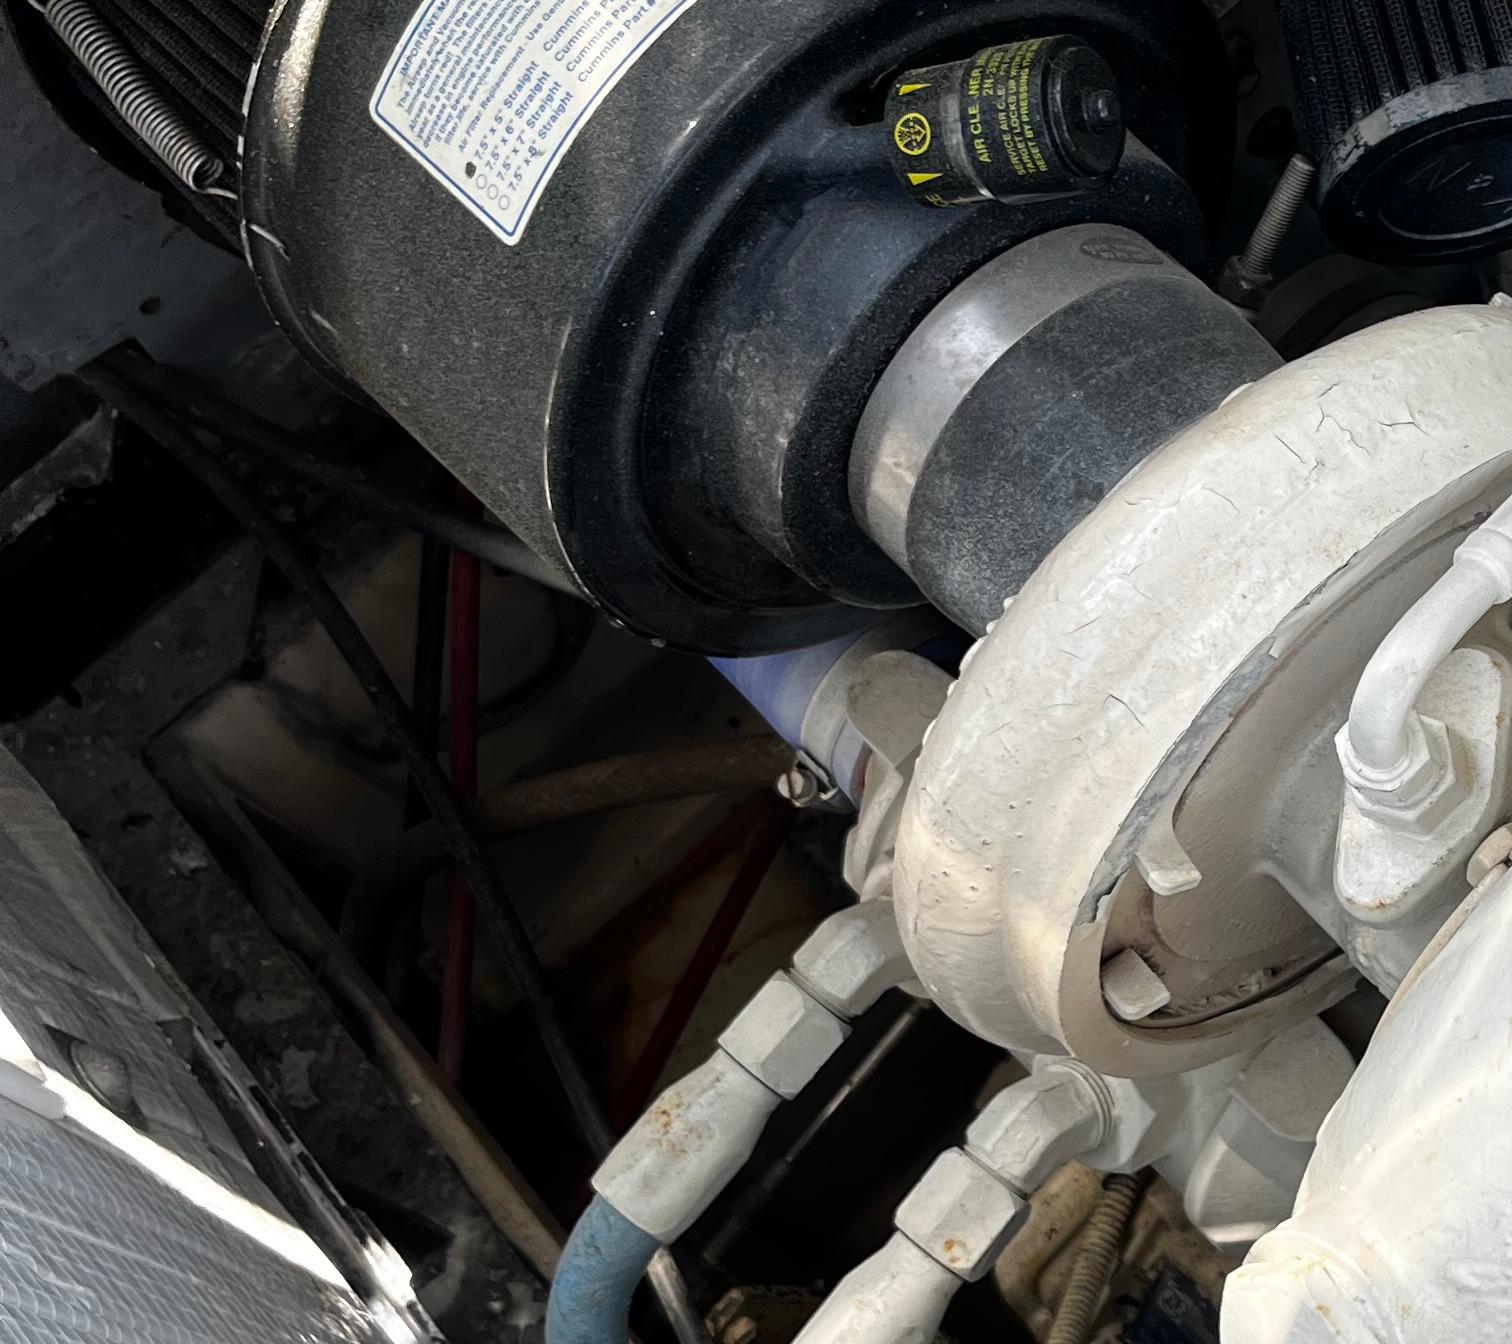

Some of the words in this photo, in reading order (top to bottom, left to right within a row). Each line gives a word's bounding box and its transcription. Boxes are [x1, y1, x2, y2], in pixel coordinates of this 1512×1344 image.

[398, 10, 440, 77] IMPORTANT
[422, 71, 441, 100] turns
[451, 27, 468, 49] The
[464, 0, 489, 30] filters
[453, 8, 469, 29] the
[396, 87, 410, 110] The
[423, 35, 439, 57] and
[416, 115, 430, 141] year
[437, 54, 464, 96] general
[422, 101, 447, 150] decrease
[449, 54, 475, 91] engine
[438, 109, 454, 136] they
[449, 69, 477, 112] become
[472, 23, 509, 71] saturated
[504, 2, 525, 25] with
[443, 119, 459, 146] filter
[465, 63, 492, 102] service
[487, 41, 507, 66] with
[457, 136, 468, 153] Air
[464, 108, 483, 137] Filter
[478, 45, 527, 111] Replacement
[524, 20, 545, 42] Use
[484, 143, 503, 172] 7.5"
[498, 134, 508, 146] x
[503, 117, 518, 136] 6"
[512, 68, 553, 121] Straight
[551, 7, 603, 63] Cummins
[495, 154, 514, 183] 7.5"
[510, 145, 520, 157] x
[515, 128, 530, 146] 7"
[524, 79, 564, 131] Straight
[563, 17, 616, 74] Cummins
[507, 164, 526, 193] 7.5"
[535, 89, 576, 141] Straight
[575, 28, 627, 84] Cummins
[621, 4, 649, 31] Part
[968, 68, 983, 135] CLENER
[1007, 79, 1017, 94] UP
[1018, 68, 1030, 122] PRESSING
[473, 133, 491, 162] 7.5"
[487, 124, 497, 136] x
[492, 107, 507, 125] 5"
[501, 58, 541, 111] Straight
[999, 112, 1009, 131] AIR
[1008, 95, 1021, 133] LOCKS
[1023, 124, 1034, 138] BY
[974, 138, 992, 163] AIR
[1002, 133, 1026, 175] SERVICE
[1014, 135, 1037, 173] TARGET
[1027, 141, 1049, 172] RESET
